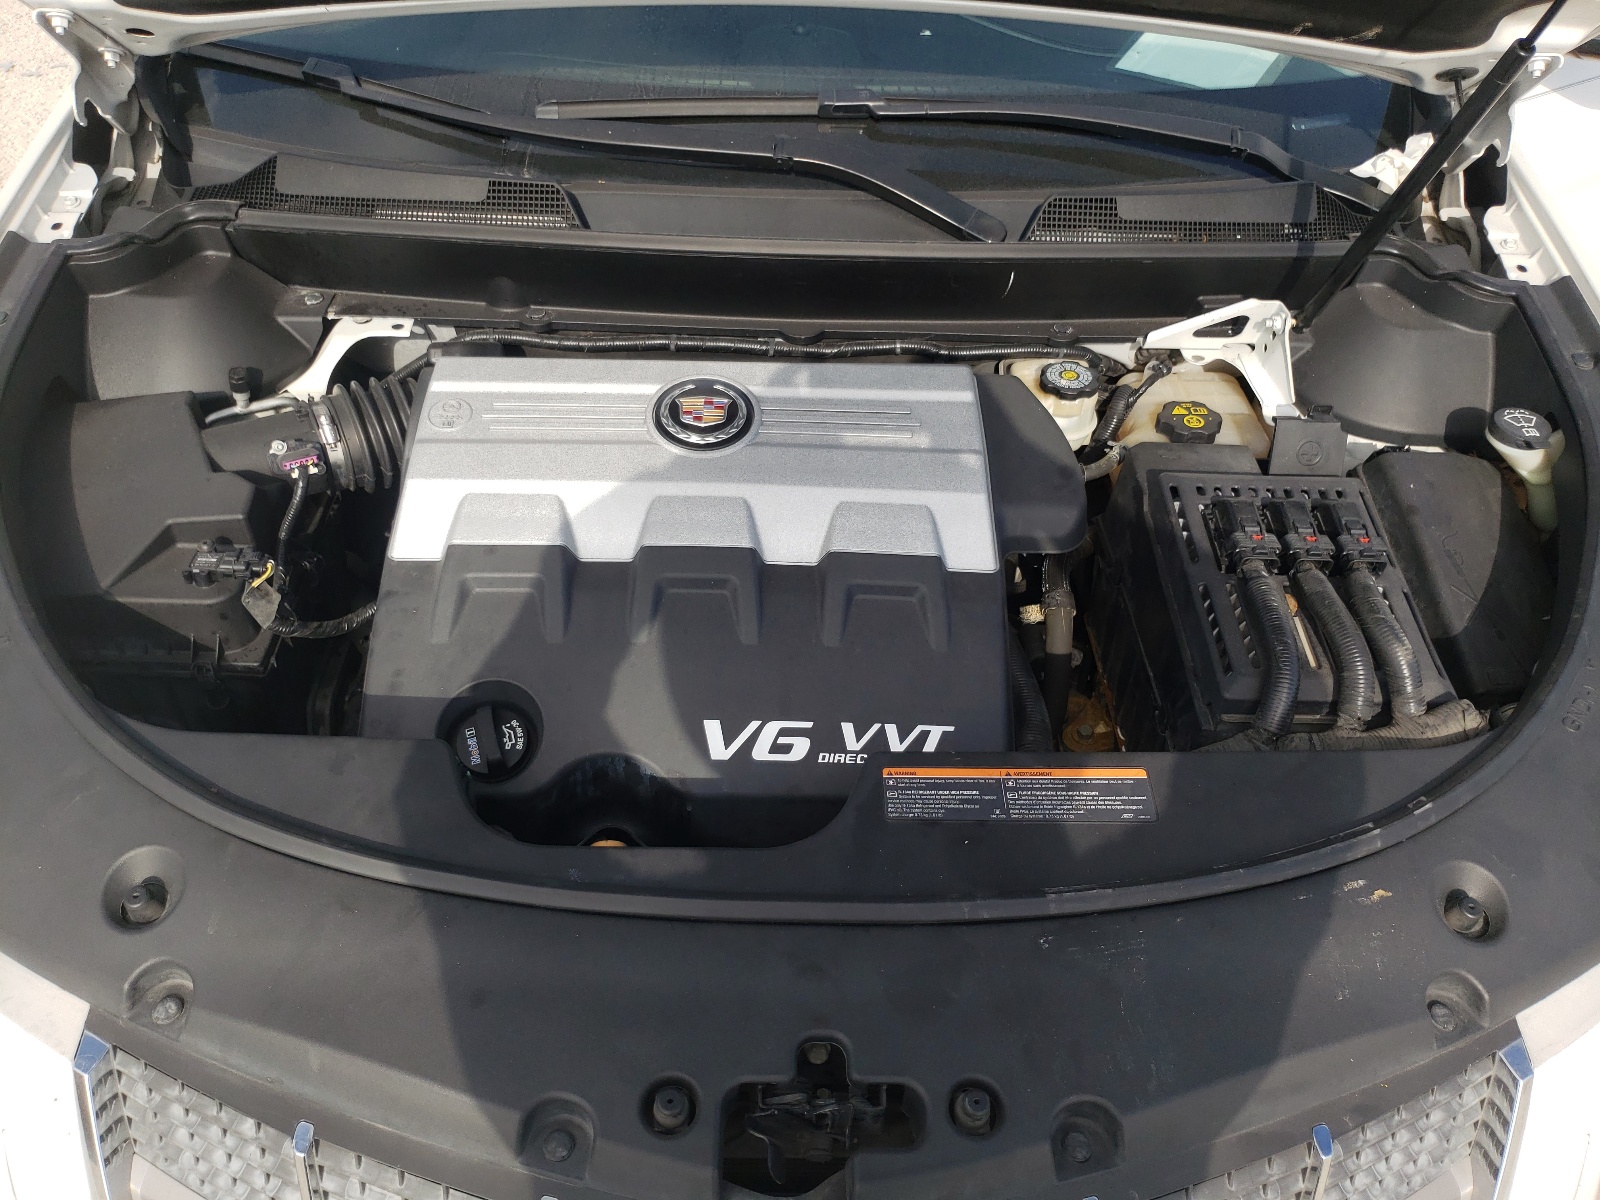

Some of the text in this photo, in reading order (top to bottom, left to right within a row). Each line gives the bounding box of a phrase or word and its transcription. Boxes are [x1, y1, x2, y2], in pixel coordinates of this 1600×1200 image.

[516, 736, 524, 750] SAE
[703, 719, 955, 761] V6 VVT
[818, 752, 868, 764] DIREC
